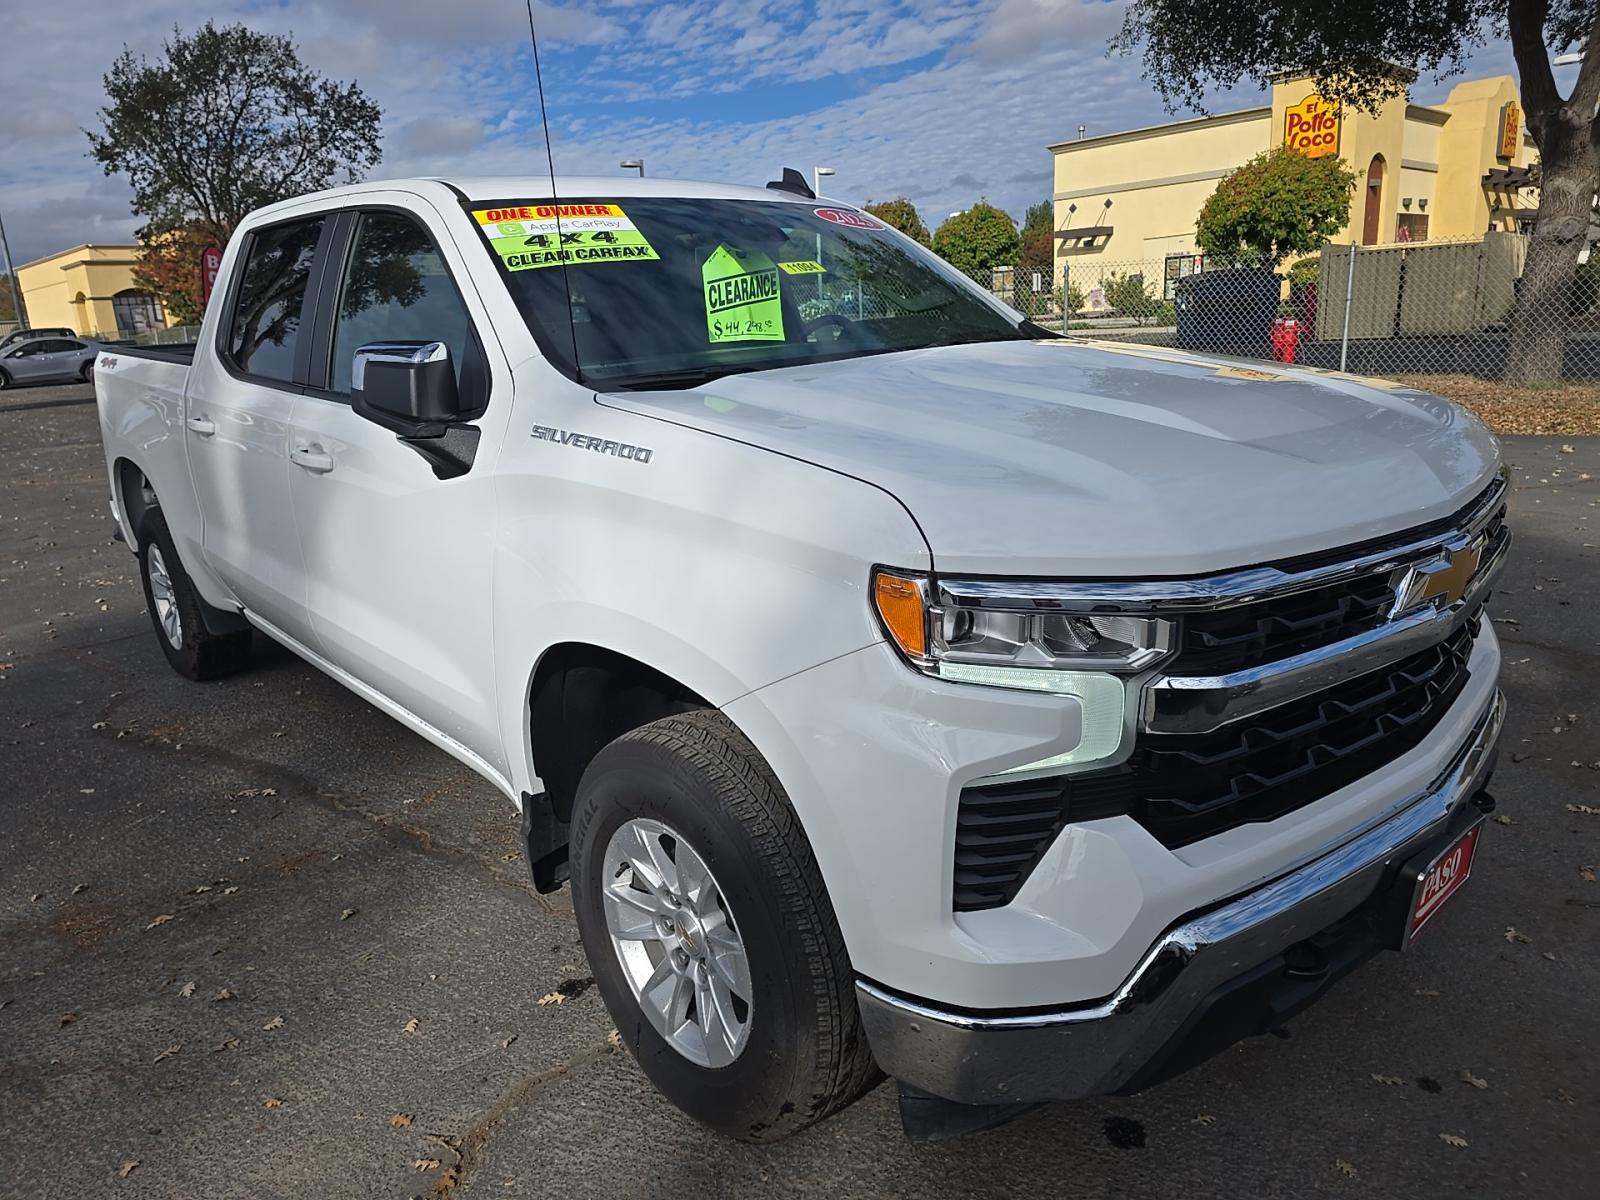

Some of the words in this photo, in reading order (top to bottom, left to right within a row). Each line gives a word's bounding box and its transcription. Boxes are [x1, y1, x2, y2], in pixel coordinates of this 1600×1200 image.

[1307, 102, 1319, 113] El
[1288, 109, 1336, 136] Pollo
[487, 207, 533, 221] ONE
[536, 205, 610, 217] OWNER
[529, 222, 569, 233] Appe
[571, 220, 621, 230] CarPlay
[524, 234, 553, 248] 4
[591, 231, 619, 244] 4
[507, 250, 574, 267] CLEAN
[575, 246, 649, 260] CARFAX
[708, 272, 778, 309] CLEARANCE
[530, 424, 654, 464] SILVERADO
[1420, 847, 1462, 906] PASO
